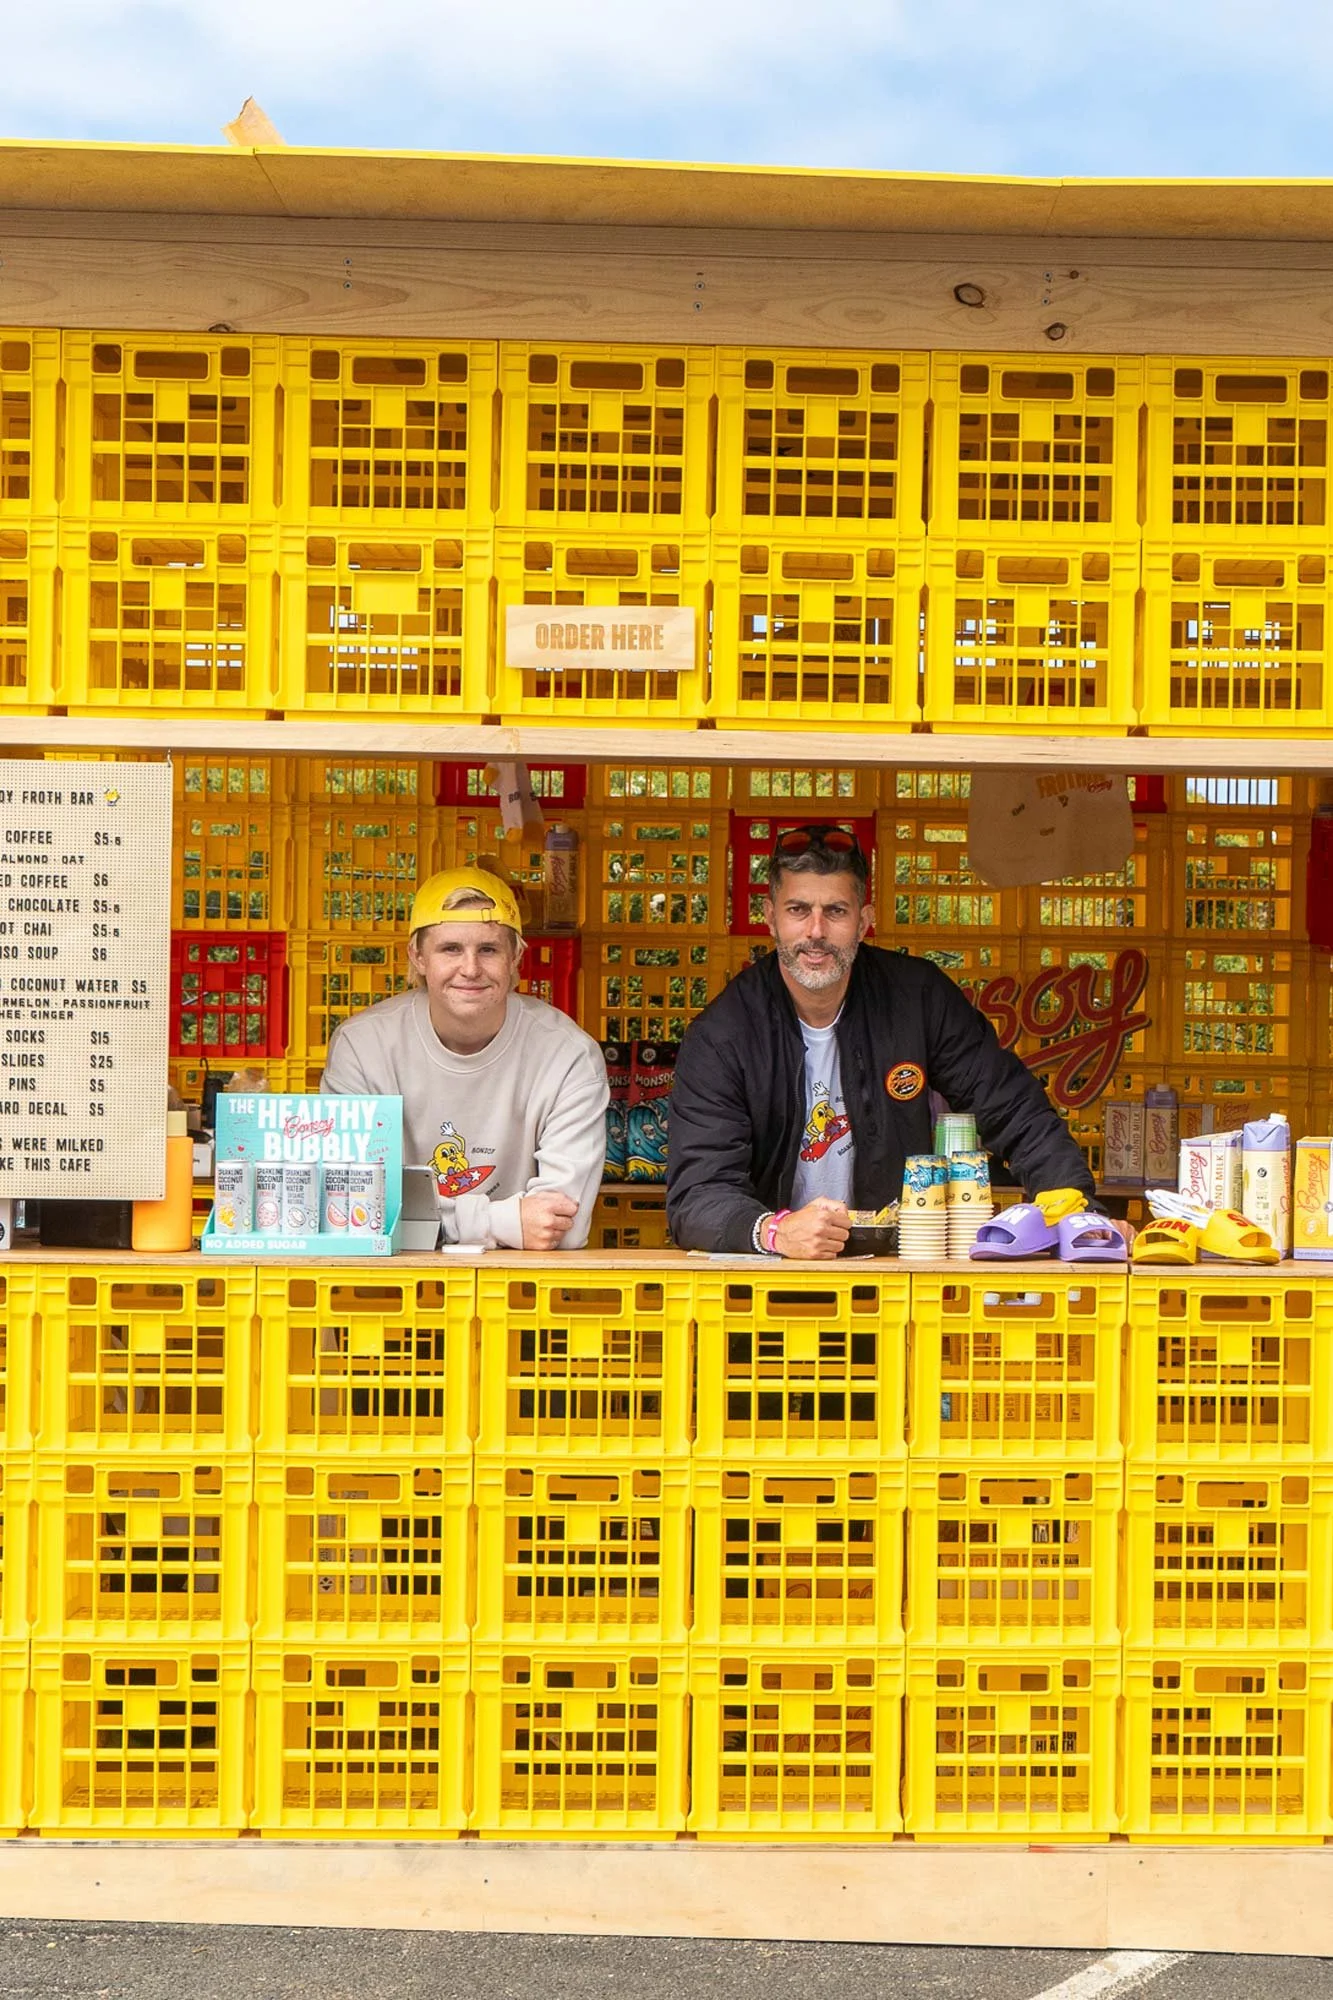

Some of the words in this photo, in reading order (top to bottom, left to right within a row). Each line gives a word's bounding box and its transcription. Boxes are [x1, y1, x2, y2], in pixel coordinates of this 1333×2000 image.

[535, 623, 605, 651] ORDER
[611, 624, 664, 651] HERE
[23, 791, 61, 804] FROTH
[71, 792, 93, 804] BAR
[6, 831, 52, 844] COFFEE
[1, 855, 48, 864] ALMOND
[62, 856, 83, 864] OAT
[21, 875, 67, 888] COFFEE
[94, 874, 108, 886] $6
[9, 898, 79, 912] CHOCOLATE
[0, 922, 14, 934] OT
[24, 923, 51, 936] CHAI
[28, 947, 58, 959] SOUP
[93, 948, 106, 960] $6
[11, 978, 65, 992] COCONUT
[76, 980, 118, 993] WATER
[132, 980, 146, 993] $5
[64, 999, 149, 1009] PASSIONFRUIT
[31, 1011, 73, 1019] GINGER
[963, 949, 1152, 1109] soy
[6, 1030, 44, 1043] SOCKS
[91, 1031, 109, 1044] $15
[2, 1054, 44, 1067] SLIDES
[90, 1055, 112, 1068] $25
[9, 1078, 35, 1090] PINS
[90, 1079, 104, 1092] $5
[29, 1102, 67, 1115] DECAL
[90, 1103, 103, 1116] $5
[229, 1099, 255, 1114] THE
[258, 1099, 377, 1130] HEALTHY
[12, 1138, 46, 1151] WERE
[57, 1139, 103, 1152] MILKED
[264, 1132, 371, 1162] BUBBLY
[24, 1158, 50, 1171] THIS
[60, 1159, 90, 1171] CAFE
[1215, 1154, 1224, 1180] MILK
[205, 1239, 222, 1248] NO
[225, 1239, 264, 1249] ADDED
[267, 1240, 307, 1249] SUGAR
